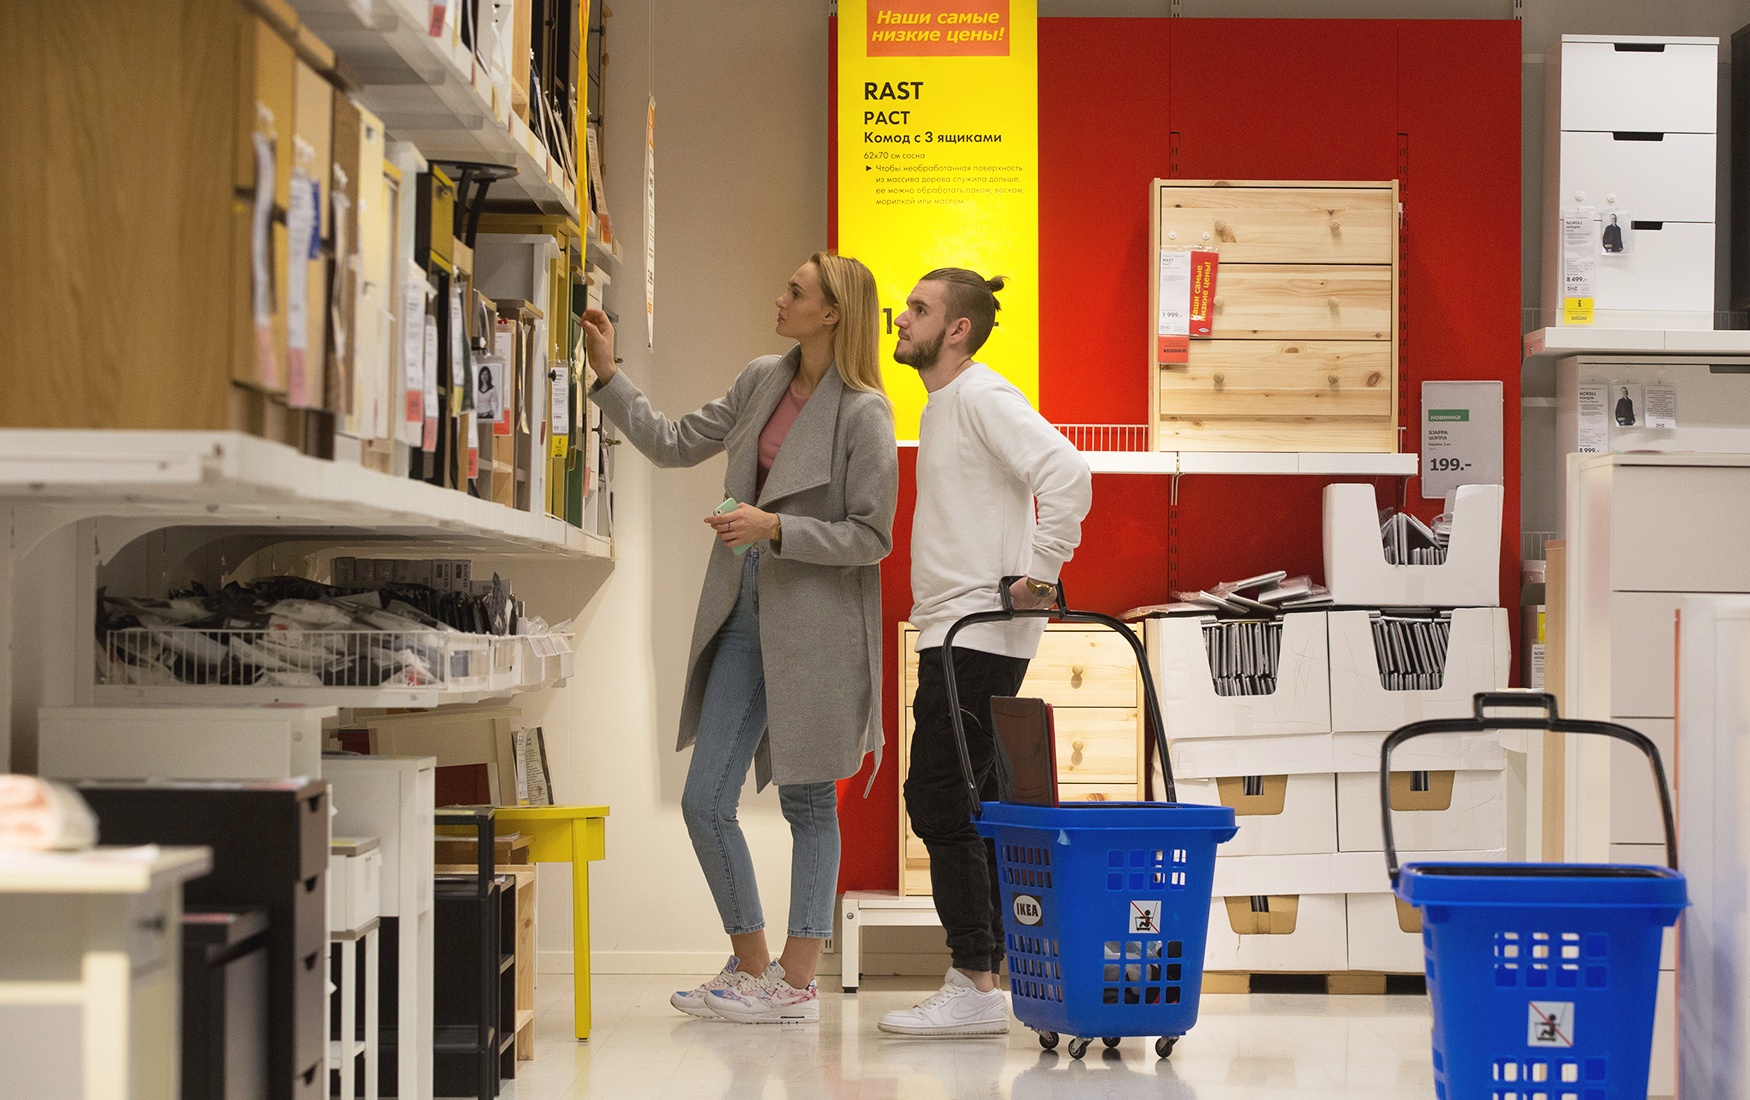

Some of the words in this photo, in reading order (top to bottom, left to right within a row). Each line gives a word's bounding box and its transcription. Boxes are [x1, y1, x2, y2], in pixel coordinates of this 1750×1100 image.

[876, 10, 931, 24] Наши
[937, 12, 1000, 24] самые
[871, 29, 941, 42] низкие
[946, 27, 1005, 43] цены!
[864, 81, 924, 100] RAST
[864, 110, 911, 125] РАСТ
[864, 131, 911, 144] Комод
[914, 134, 921, 143] с
[924, 131, 934, 143] 3
[937, 134, 1002, 144] ящиками
[875, 164, 902, 172] Чтобы
[903, 164, 972, 173] необработанная
[973, 165, 1024, 173] поверхность
[952, 176, 987, 184] служила
[916, 186, 964, 195] обработать
[875, 198, 915, 206] морилкой
[1195, 265, 1203, 294] самые
[1430, 458, 1472, 471] 199.-
[1016, 902, 1039, 917] IKEA
